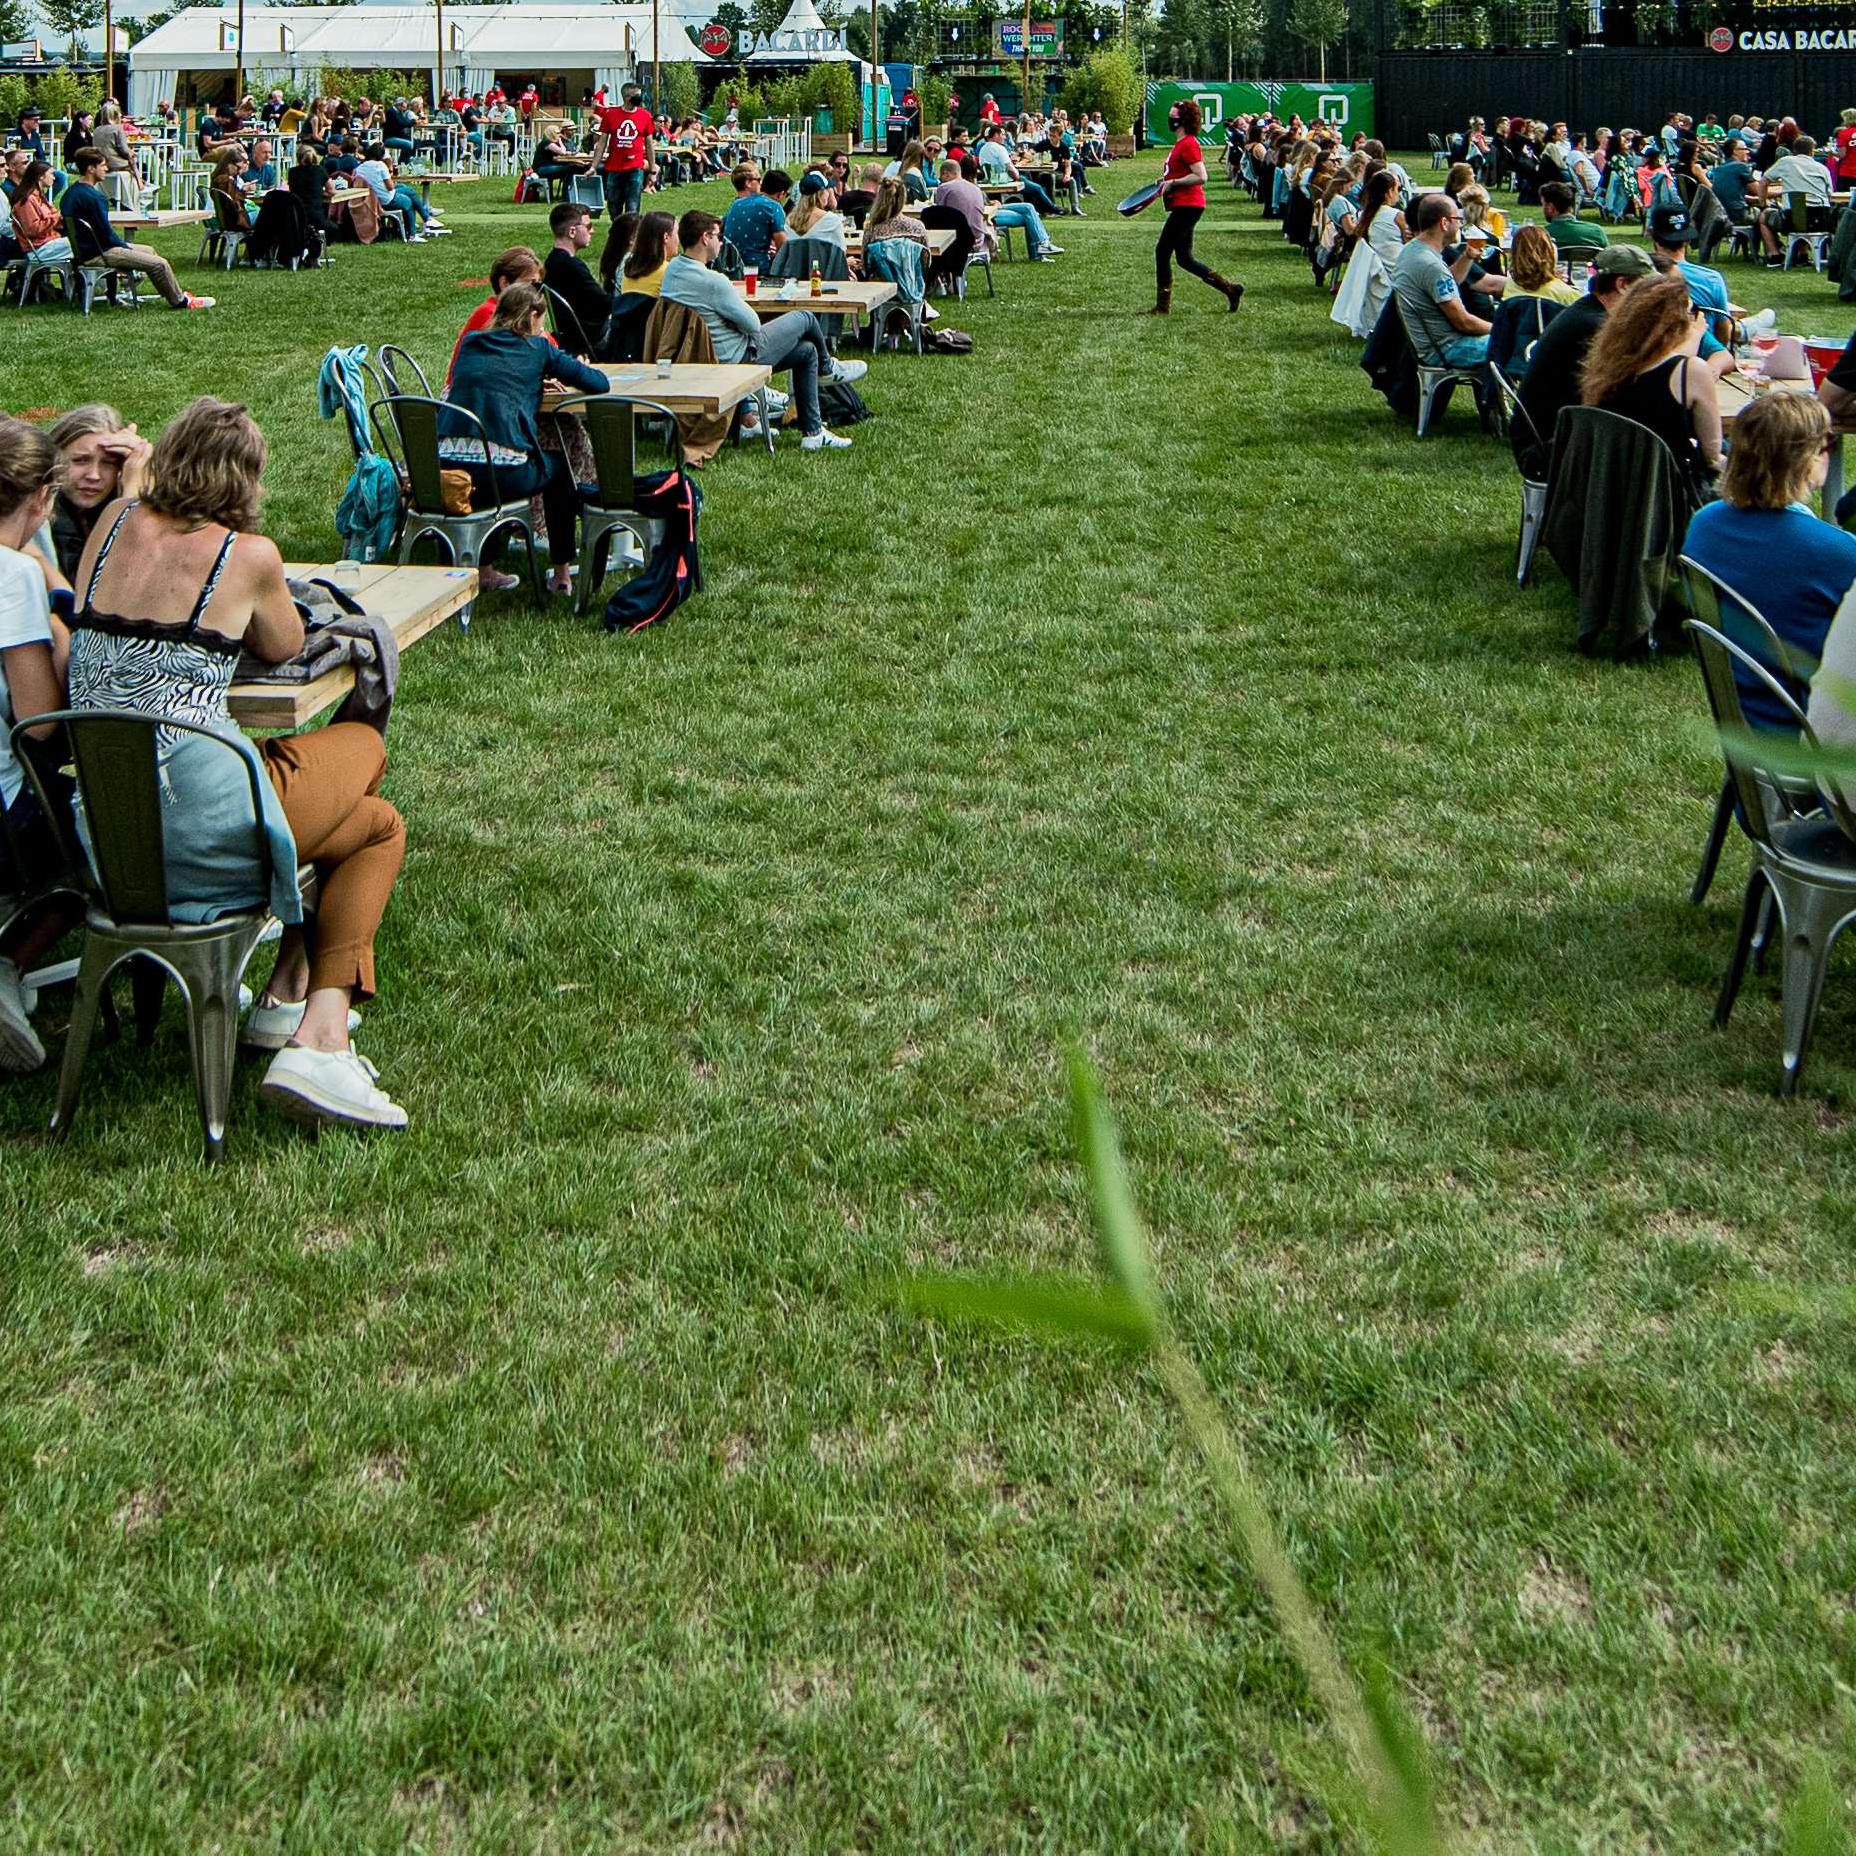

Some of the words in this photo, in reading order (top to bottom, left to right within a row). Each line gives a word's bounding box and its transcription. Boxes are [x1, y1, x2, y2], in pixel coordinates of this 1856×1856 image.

[738, 22, 848, 53] BACARDÍ
[1002, 34, 1054, 43] WERHTER
[1738, 30, 1791, 50] CASA
